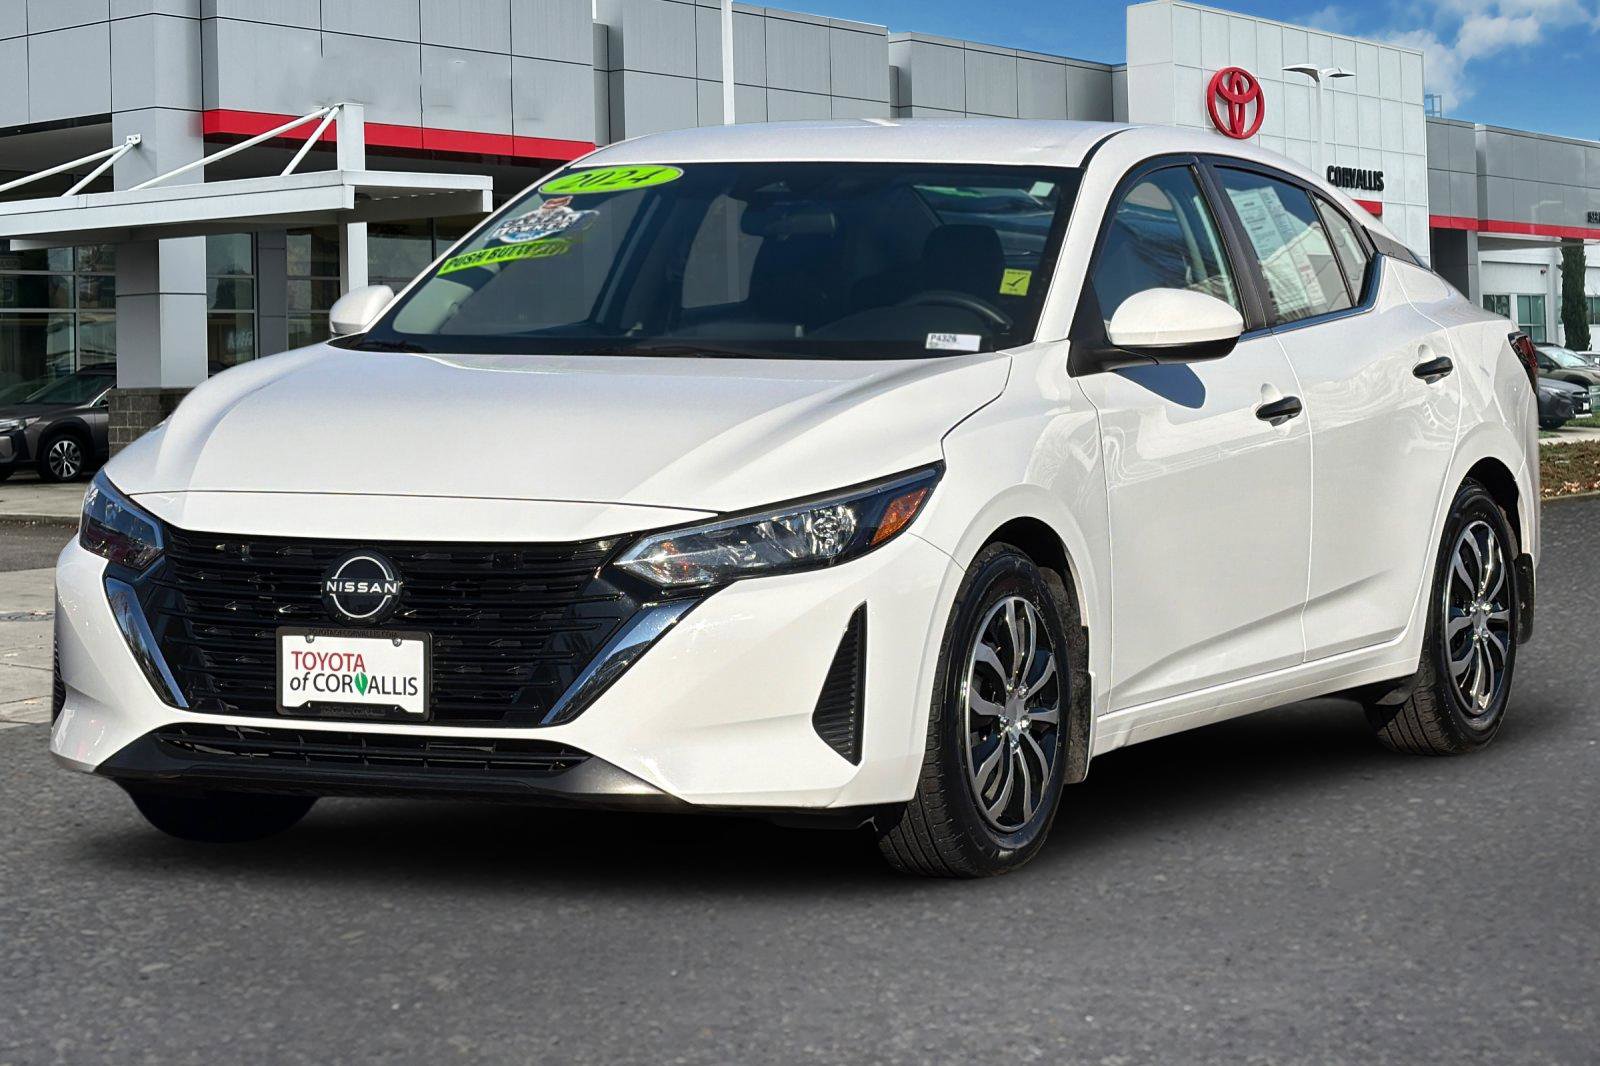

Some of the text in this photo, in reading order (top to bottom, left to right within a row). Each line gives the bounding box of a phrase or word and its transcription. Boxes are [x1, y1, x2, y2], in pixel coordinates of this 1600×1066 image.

[555, 168, 667, 190] 2024
[1327, 165, 1384, 191] CORVALLIS
[441, 249, 489, 272] PUSH
[326, 581, 397, 594] NISSAN
[291, 651, 366, 673] TOYOTA
[290, 672, 311, 692] of
